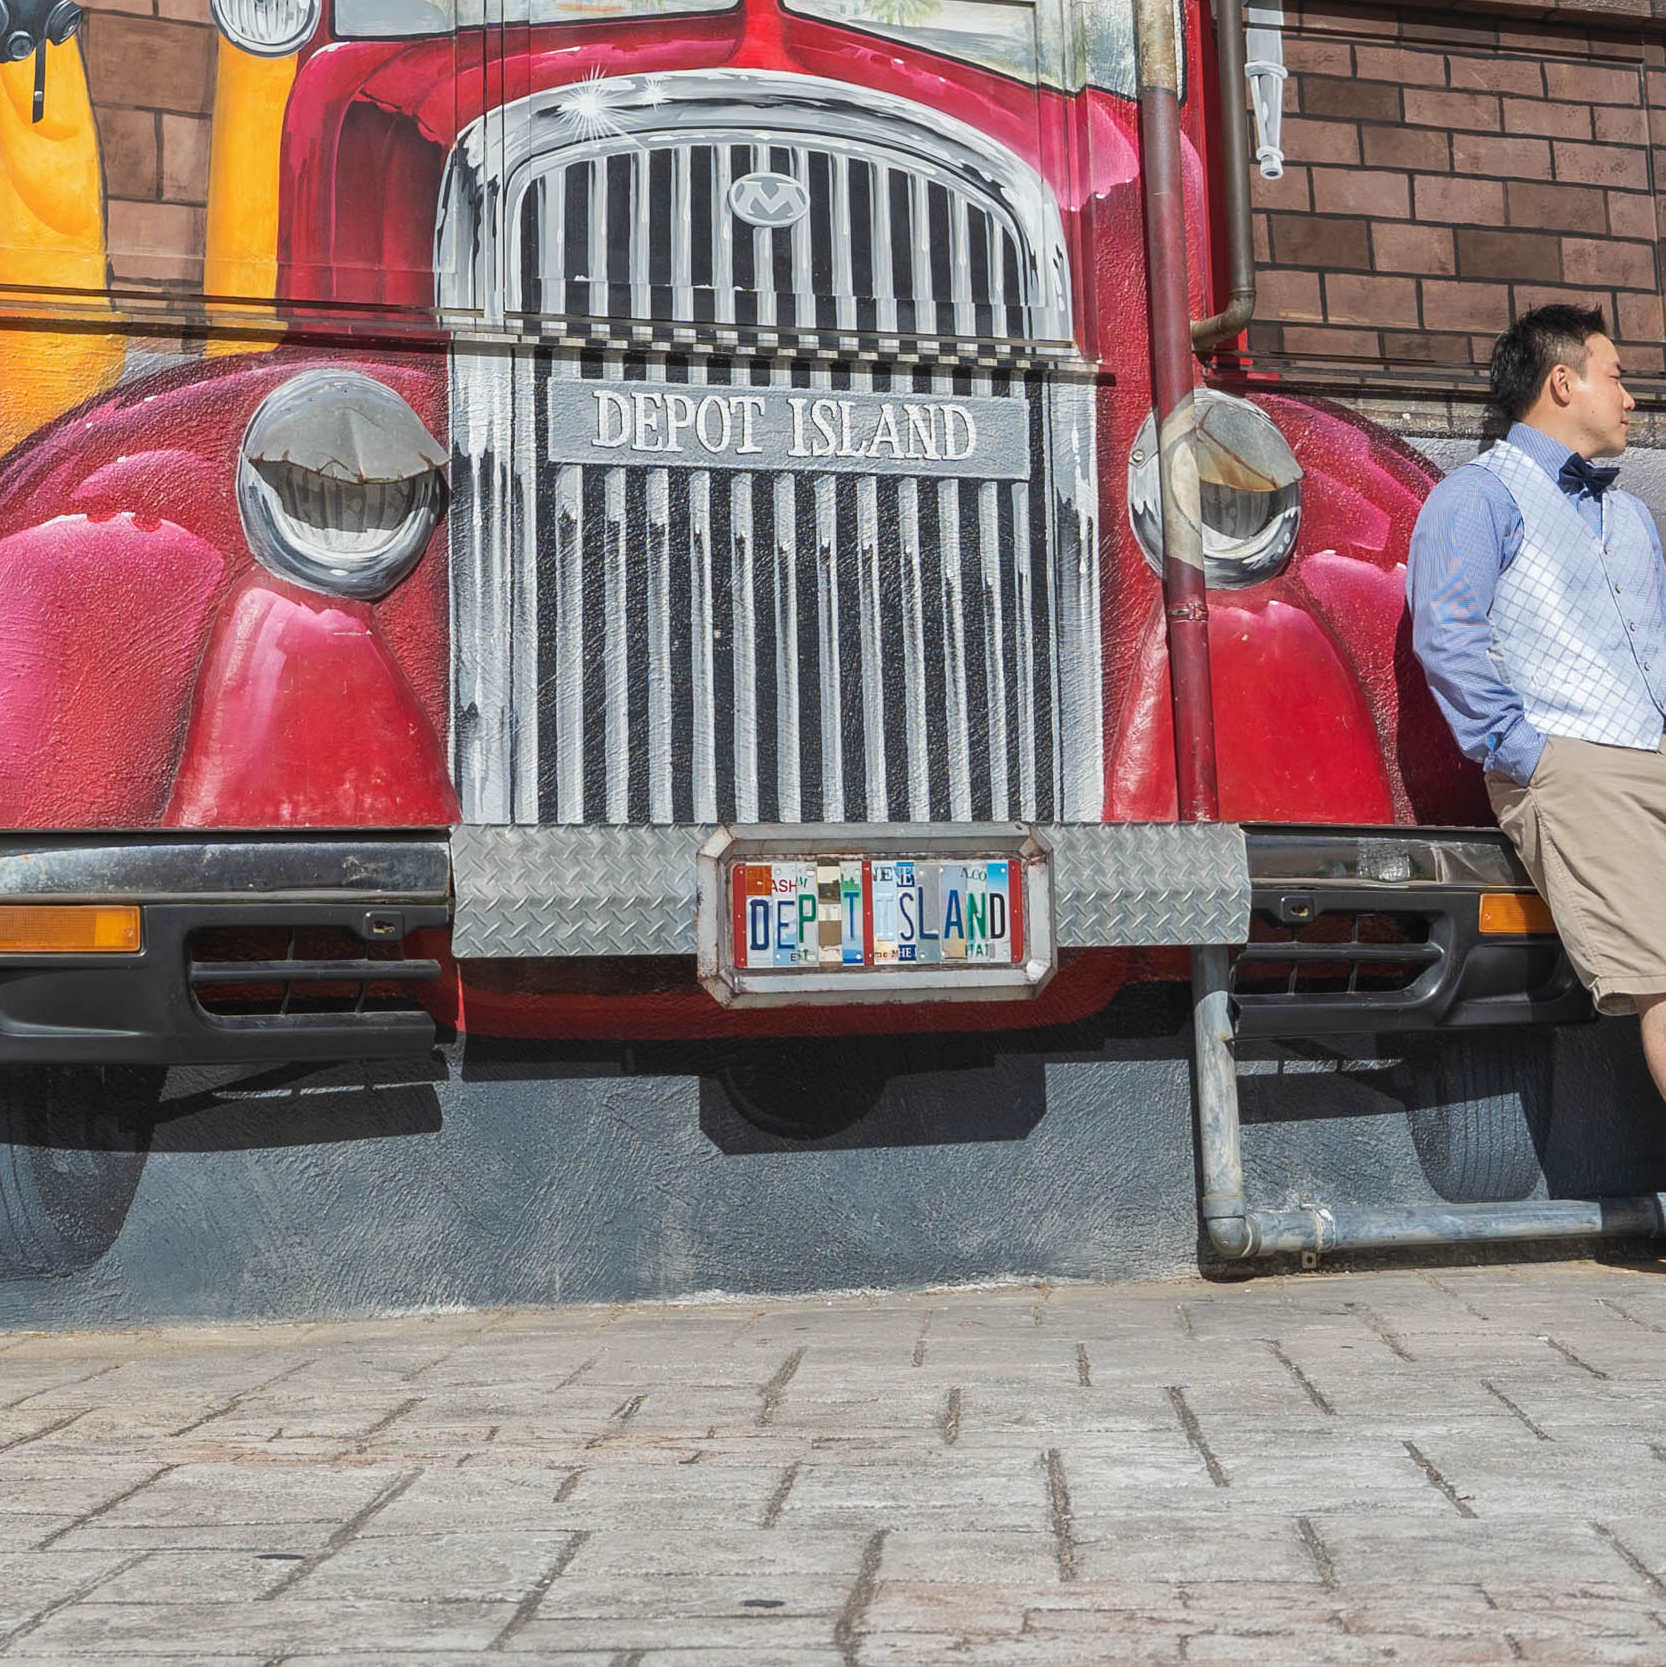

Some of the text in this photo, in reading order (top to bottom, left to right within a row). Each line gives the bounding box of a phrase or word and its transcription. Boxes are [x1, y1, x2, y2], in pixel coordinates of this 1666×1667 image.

[591, 389, 976, 462] DEPOT ISLAND
[750, 886, 1006, 950] DEPT ISLAND
